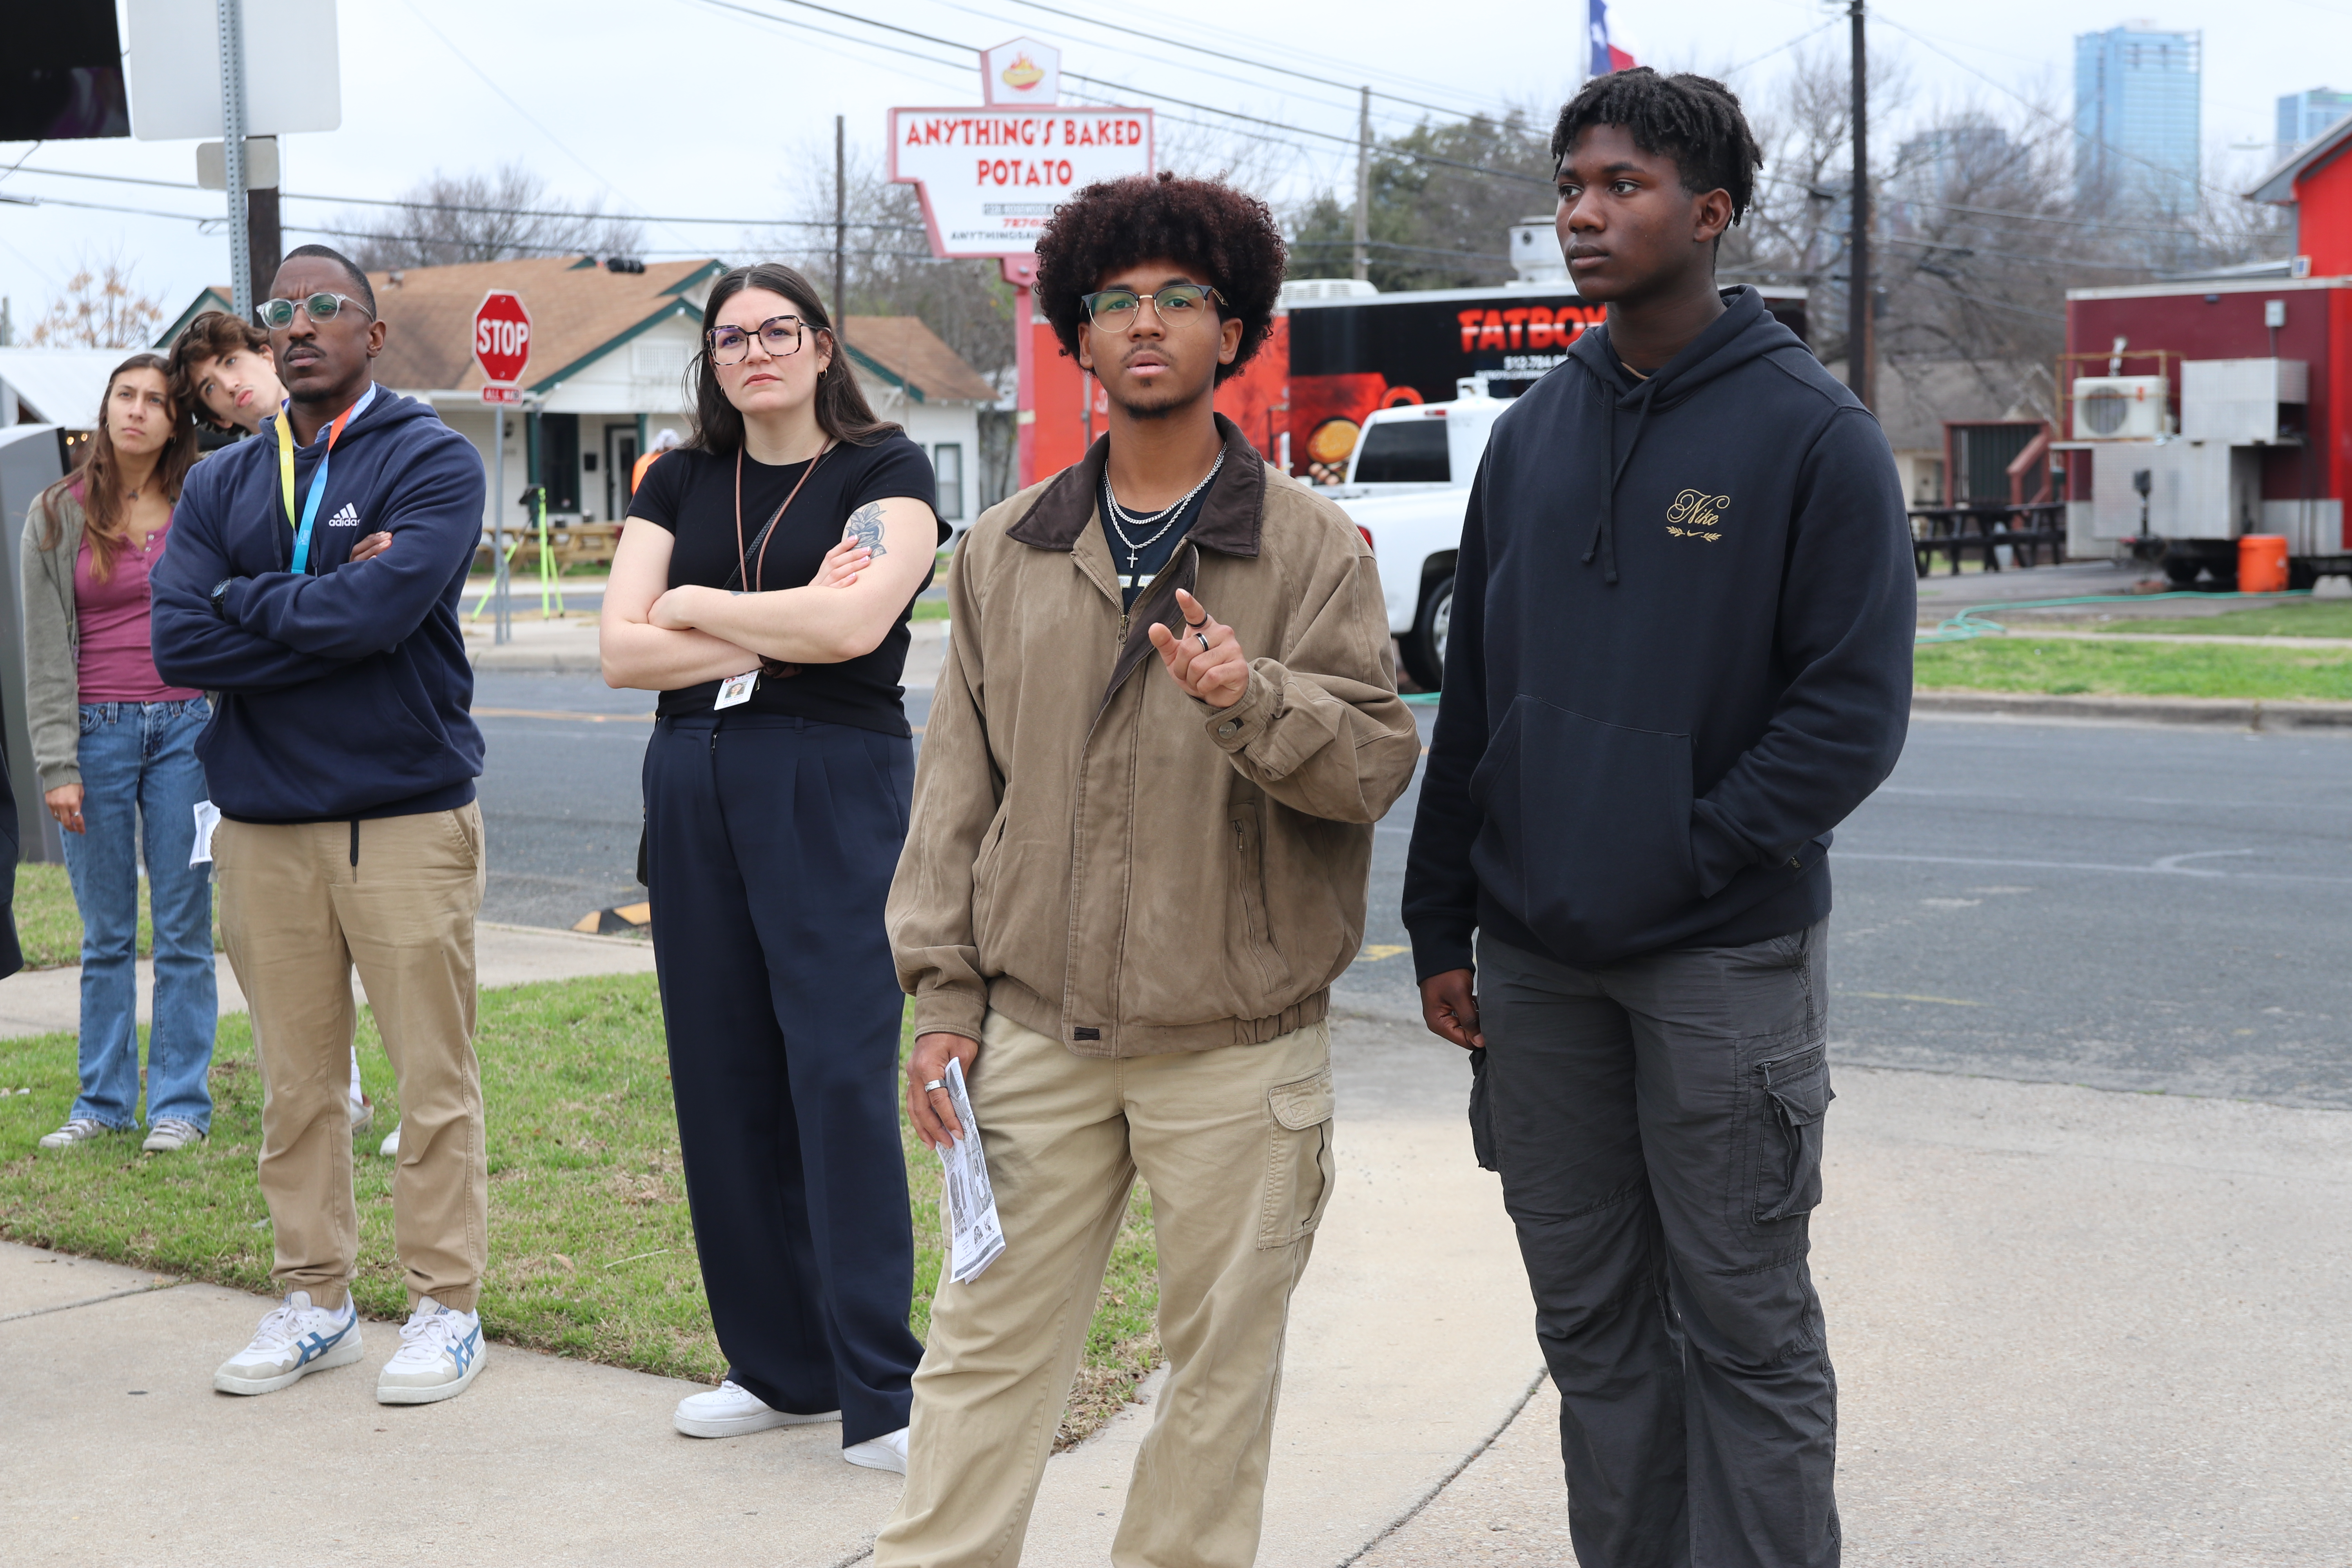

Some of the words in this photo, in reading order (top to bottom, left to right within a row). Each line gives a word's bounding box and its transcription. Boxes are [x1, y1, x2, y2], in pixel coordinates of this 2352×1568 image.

[906, 119, 1054, 147] ANYTHING'S
[1063, 119, 1142, 146] BAKED
[977, 160, 1073, 186] POTATO
[477, 318, 529, 356] STOP
[486, 388, 500, 399] ALL
[1667, 488, 1730, 526] Nike
